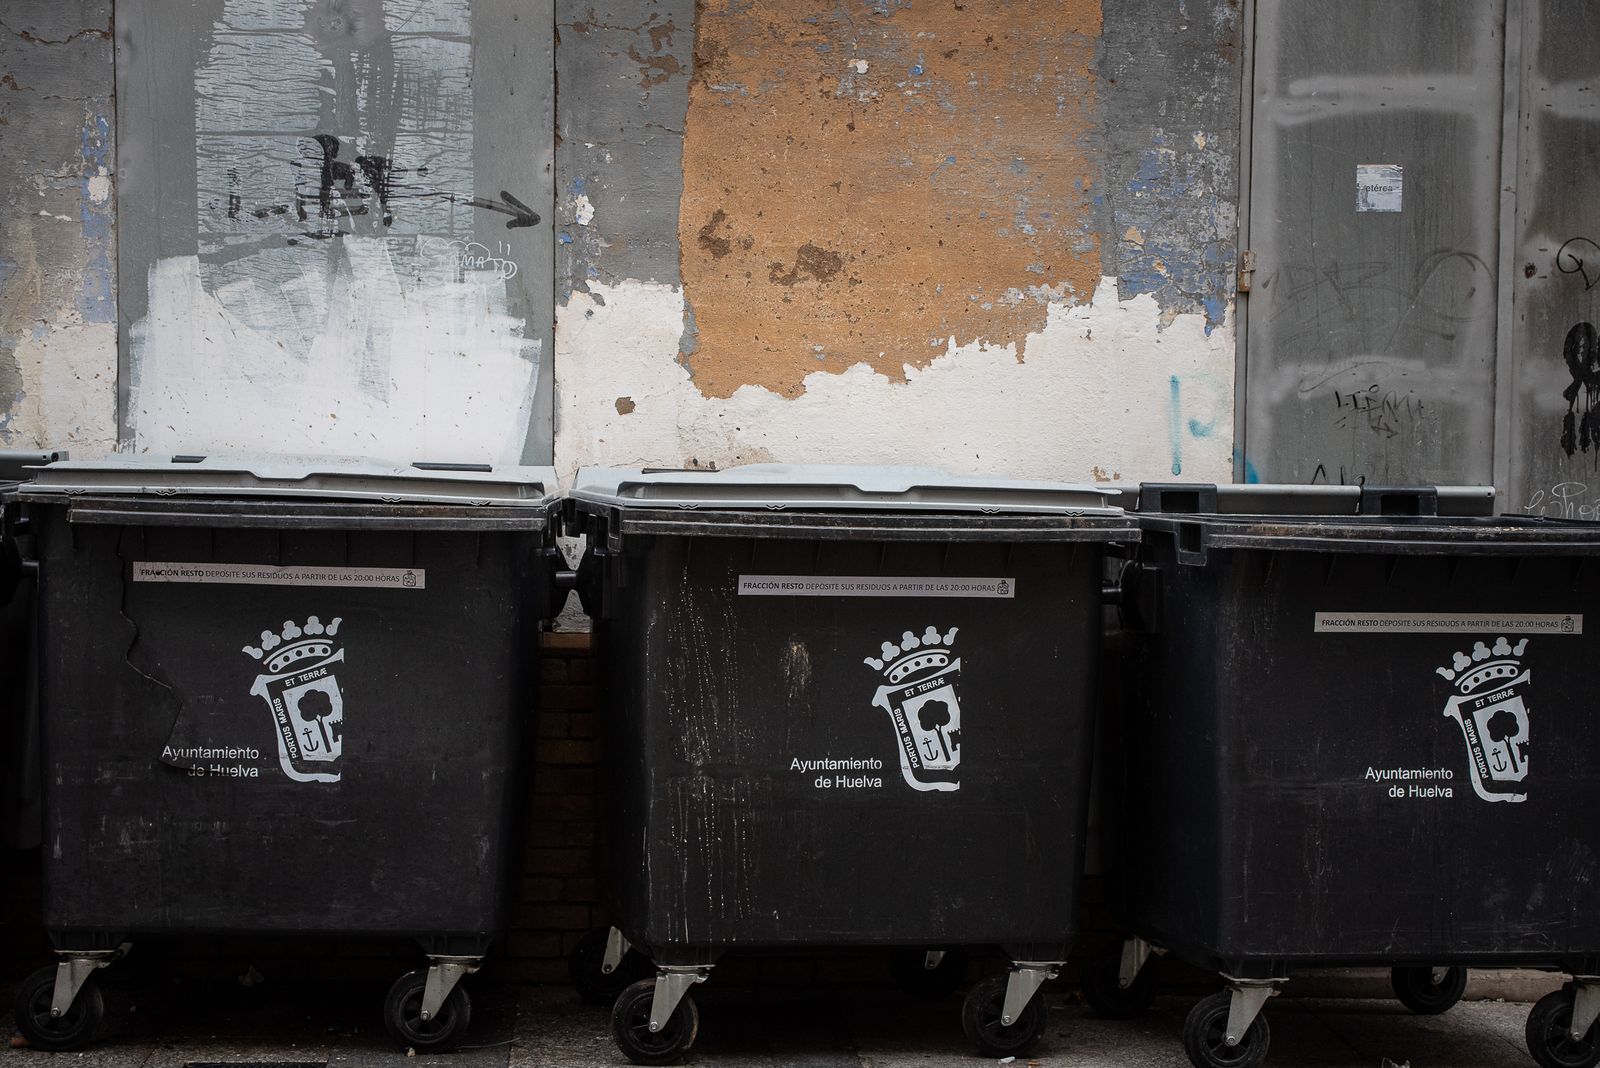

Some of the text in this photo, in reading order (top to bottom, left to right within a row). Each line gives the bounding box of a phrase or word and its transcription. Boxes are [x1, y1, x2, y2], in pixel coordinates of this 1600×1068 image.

[181, 569, 204, 577] RESTO
[206, 570, 240, 578] DEPOSITE
[242, 571, 256, 579] SUS
[258, 572, 293, 580] RESIDUOS
[302, 573, 326, 581] PARTIR
[354, 574, 374, 582] 20:00
[743, 581, 780, 590] FRACCIÓN
[782, 582, 804, 590] RESTO
[841, 583, 855, 591] SUS
[1322, 618, 1356, 627] FRACCIÓN
[285, 677, 296, 687] ET
[904, 687, 915, 697] ET
[1475, 698, 1485, 708] ET
[893, 708, 909, 734] MARIS
[273, 698, 299, 759] PORTUS MARIS
[161, 745, 260, 761] Ayuntamiento
[903, 736, 920, 769] PORTUS
[1464, 718, 1489, 779] PORTUS MARIS
[187, 763, 259, 777] de Huelva
[789, 757, 883, 774] Ayuntamiento
[814, 775, 883, 788] de Huelva
[1364, 766, 1454, 783] Ayuntamiento
[1388, 784, 1454, 798] de Huelva
